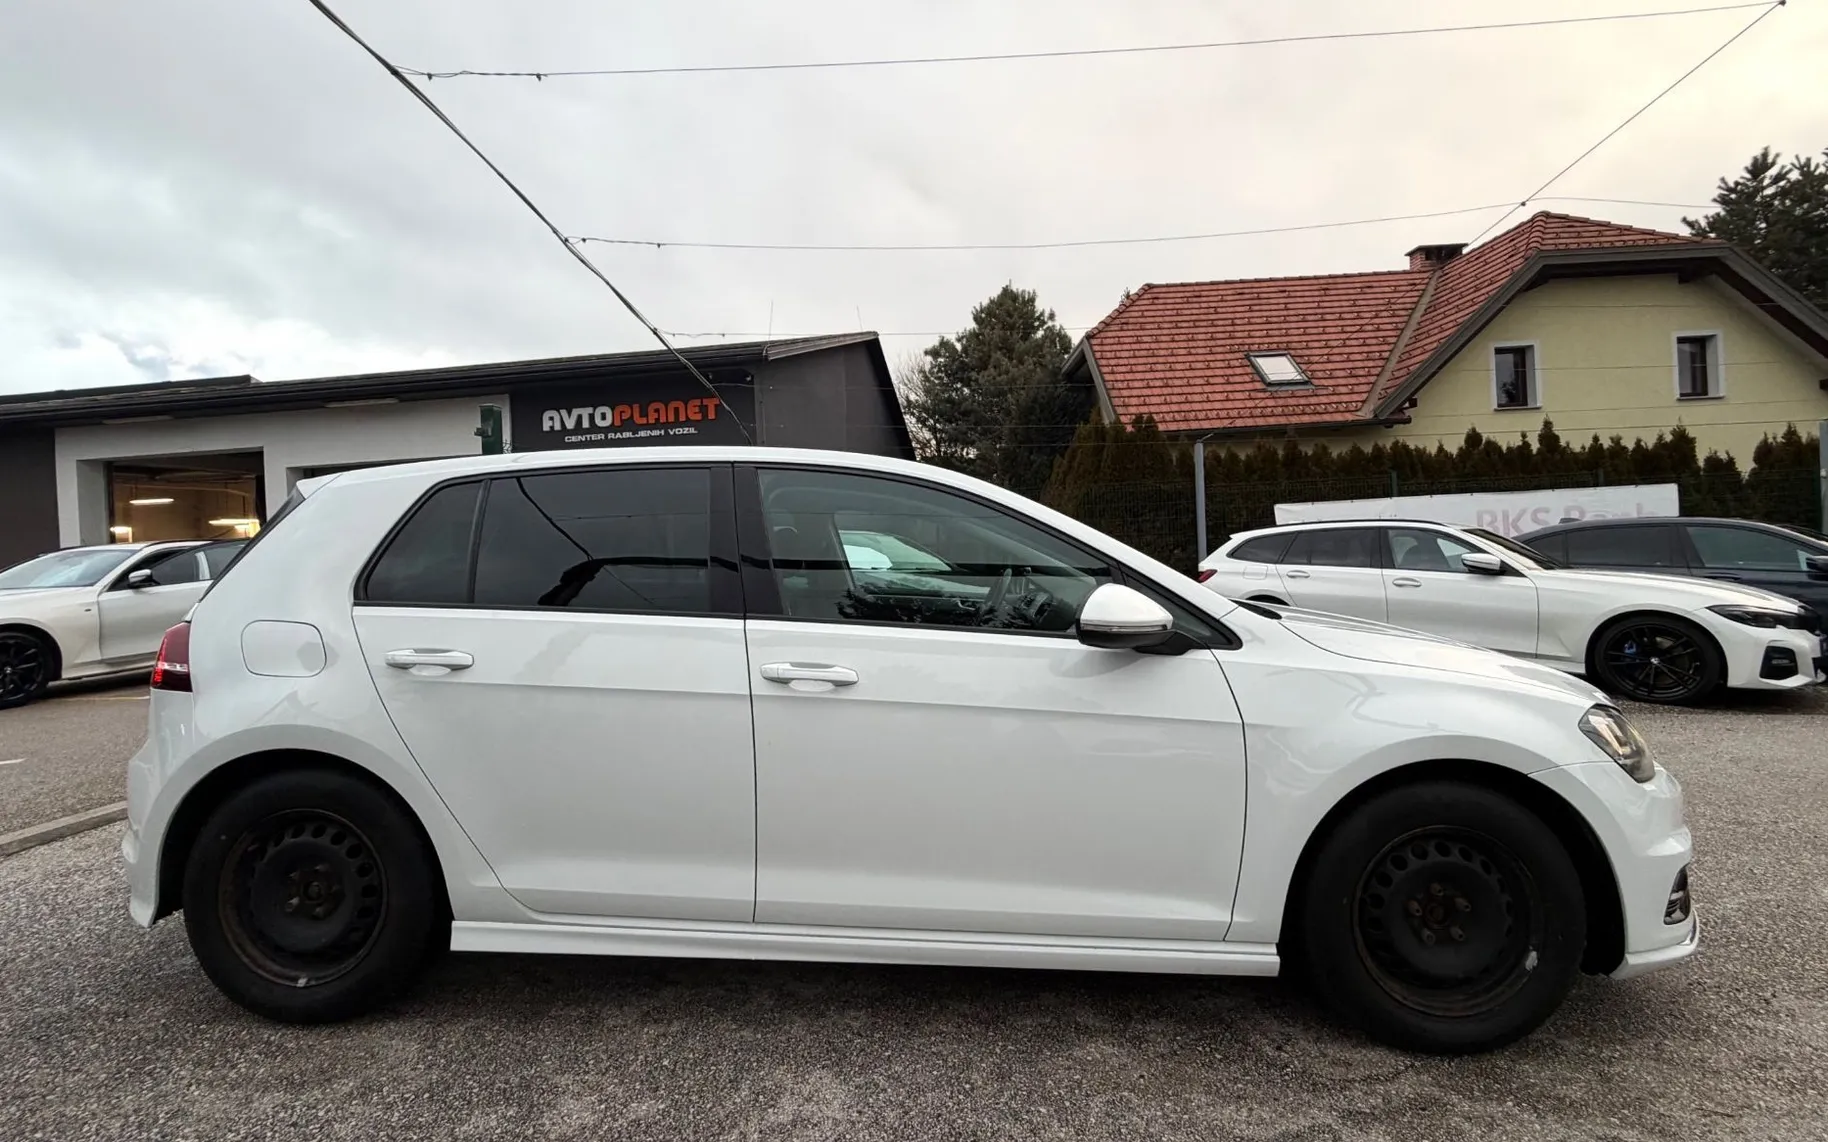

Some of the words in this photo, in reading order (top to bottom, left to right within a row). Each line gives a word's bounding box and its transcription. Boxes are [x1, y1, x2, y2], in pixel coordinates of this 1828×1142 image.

[542, 398, 720, 431] AVTOPLANET
[565, 433, 605, 442] CENTER
[607, 428, 664, 439] RABLJENIH
[668, 427, 698, 435] VOZIL
[1476, 506, 1551, 538] BKS
